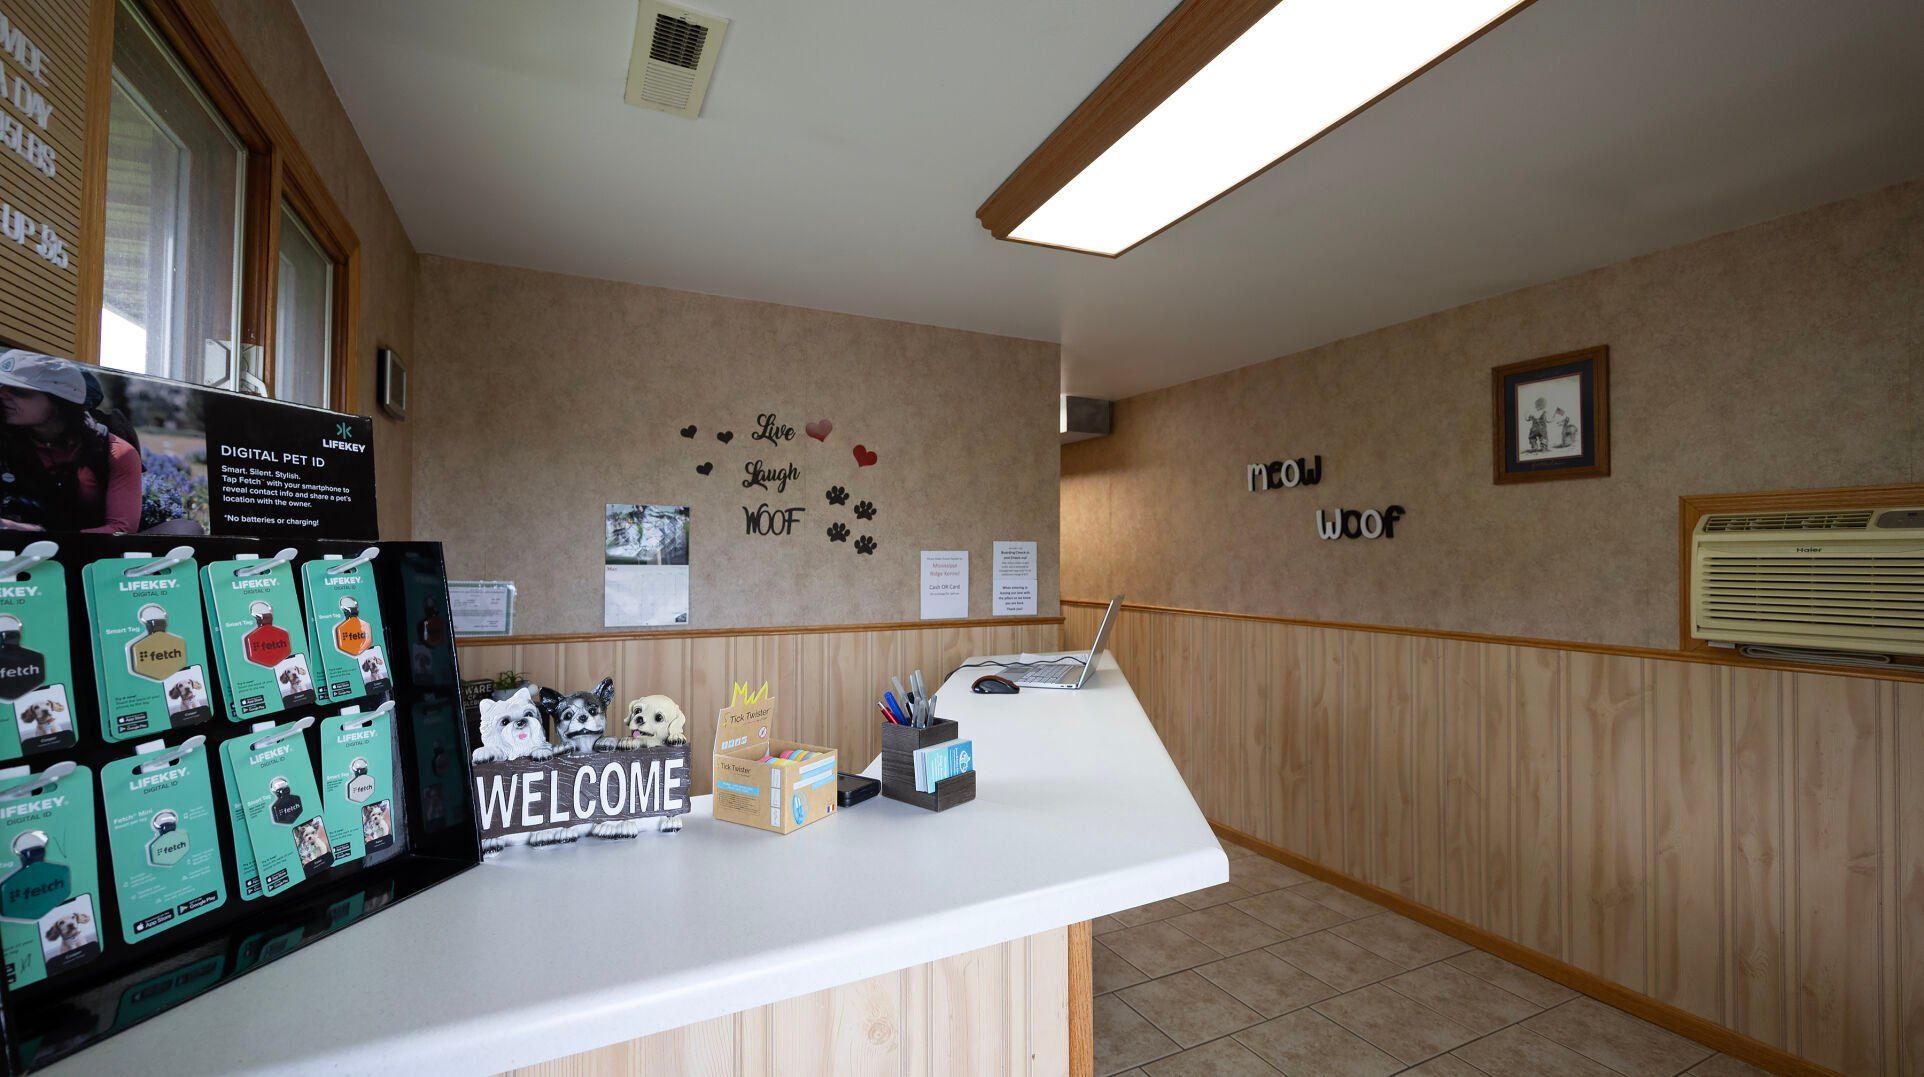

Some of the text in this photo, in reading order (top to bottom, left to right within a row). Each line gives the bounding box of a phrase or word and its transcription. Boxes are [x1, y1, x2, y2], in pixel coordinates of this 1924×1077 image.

[14, 76, 54, 130] DAY
[751, 413, 796, 447] Live
[322, 438, 366, 453] LIFEKEY
[221, 445, 325, 468] DIGITAL PET ID
[221, 465, 301, 481] Smart. Silent. Stylish.
[742, 459, 800, 493] Laugh
[222, 474, 237, 484] Tap
[266, 479, 283, 487] with
[284, 482, 301, 490] your
[302, 483, 341, 493] smartphone
[343, 486, 350, 494] to
[222, 485, 248, 494] reveal
[249, 487, 278, 496] contact
[279, 489, 294, 498] info
[295, 490, 308, 499] and
[309, 492, 329, 501] share
[335, 495, 351, 503] pet's
[223, 495, 255, 504] location
[256, 497, 273, 505] with
[274, 499, 287, 507] the
[241, 515, 275, 524] batteries
[286, 518, 320, 527] charging!
[742, 502, 806, 536] WOOF
[1796, 546, 1823, 554] Haier
[119, 578, 177, 592] LIFEKEY
[231, 578, 278, 590] LIFEKEY
[324, 576, 361, 586] LIFEKEY
[127, 626, 141, 635] Tag
[261, 639, 287, 650] fetch
[150, 648, 182, 661] fetch
[0, 664, 40, 679] fetch
[730, 713, 745, 725] Tick
[746, 708, 771, 721] Twister
[336, 729, 377, 744] LIFEKEY
[249, 744, 290, 766] LIFEKEY
[721, 762, 752, 775] Tick Twister
[129, 766, 187, 792] LIFEKEY
[143, 783, 170, 796] DIGITAL
[357, 785, 373, 793] fetch
[476, 758, 684, 831] WELCOME
[137, 808, 153, 817] Mini
[283, 803, 300, 814] fetch
[6, 814, 41, 827] DIGITAL
[163, 841, 187, 855] fetch
[22, 878, 65, 900] fetch
[189, 900, 207, 910] Google
[206, 895, 217, 904] Play
[145, 920, 157, 928] App
[157, 914, 173, 925] Store
